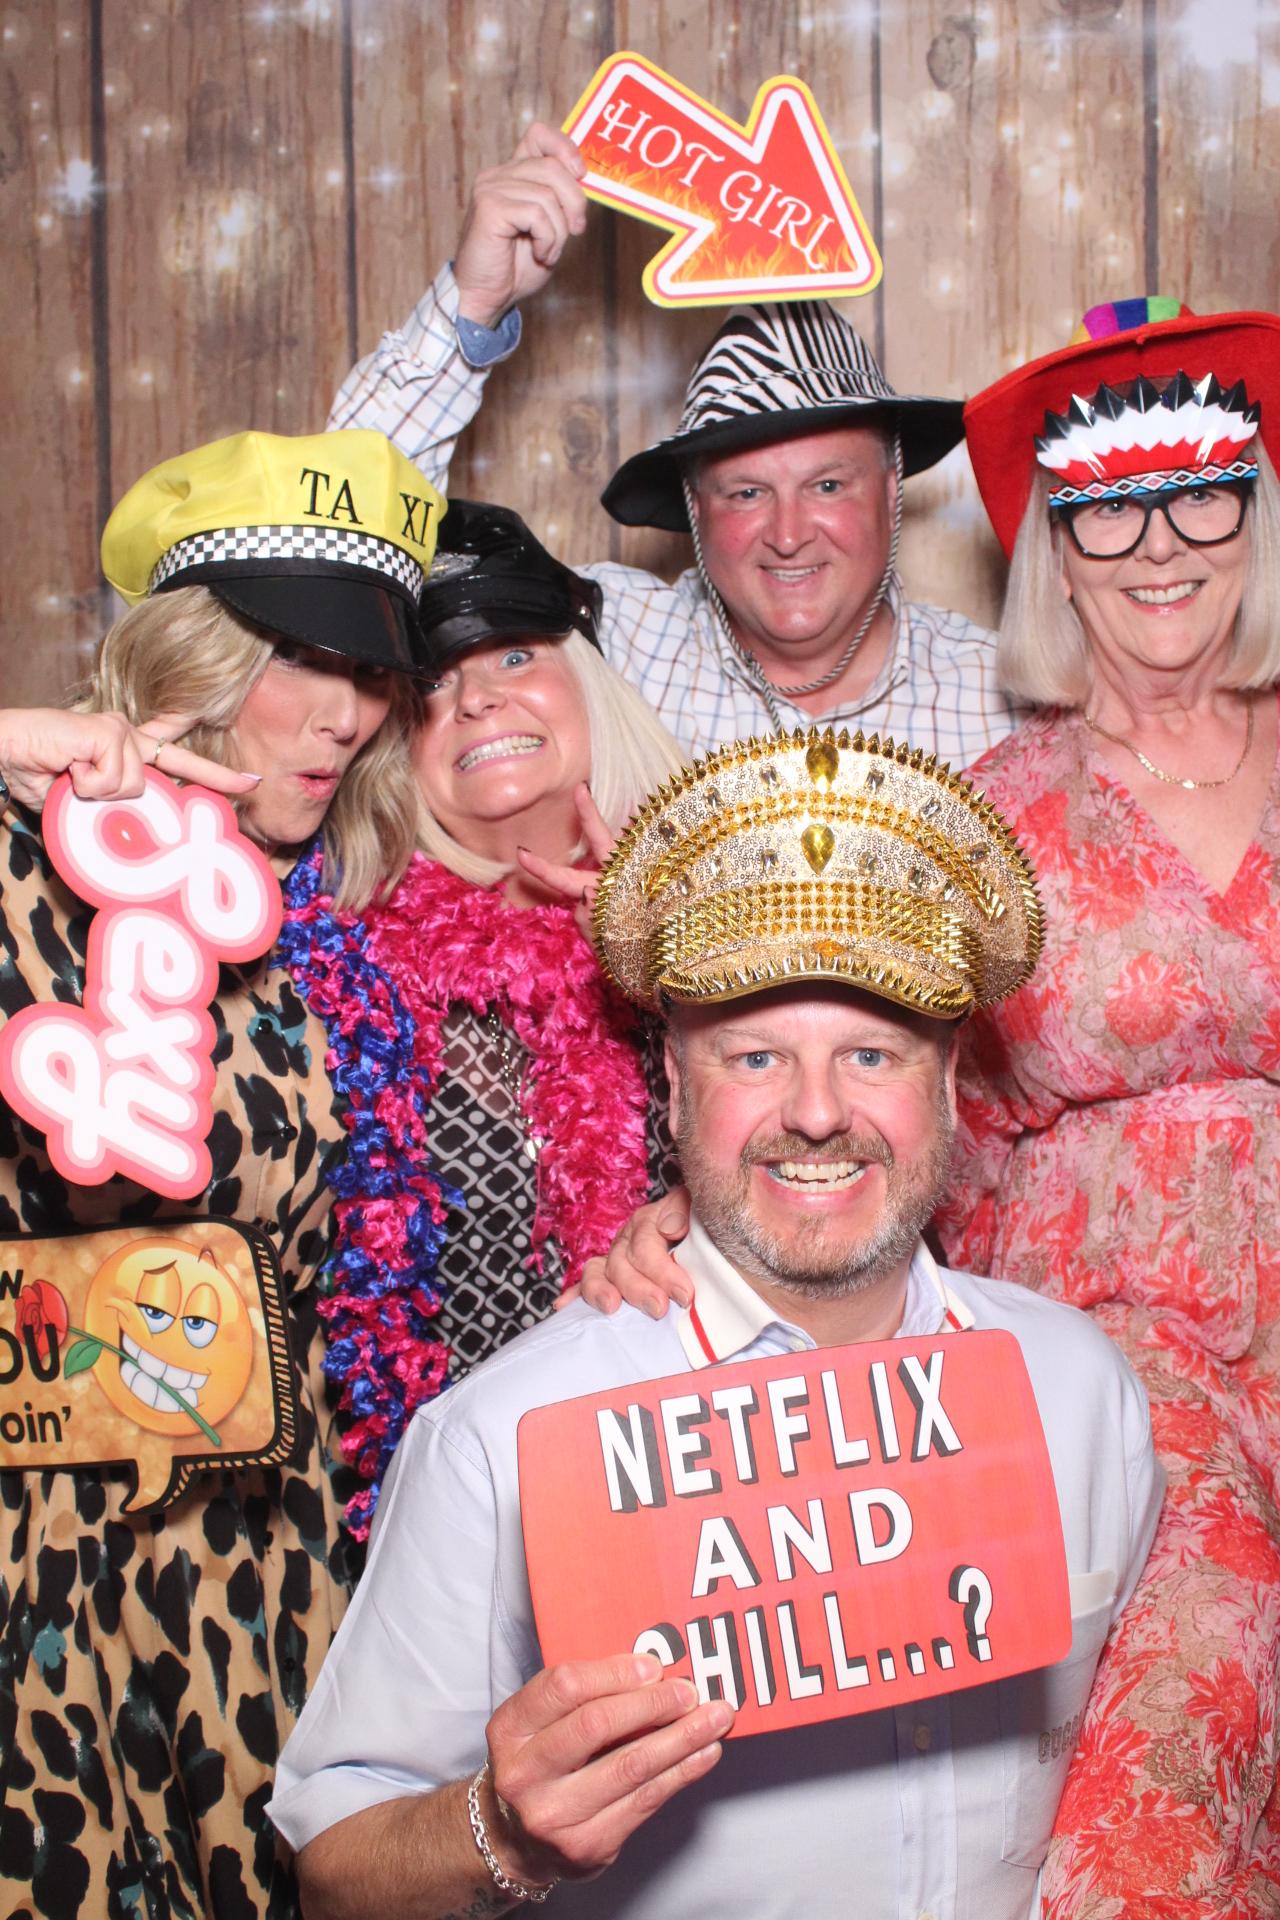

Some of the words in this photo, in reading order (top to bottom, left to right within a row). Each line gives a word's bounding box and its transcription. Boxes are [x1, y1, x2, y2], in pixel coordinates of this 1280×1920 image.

[597, 99, 725, 188] HOT
[719, 170, 835, 271] GIRL
[20, 775, 259, 1176] Sexy
[596, 1350, 963, 1513] NETFLIX
[691, 1487, 913, 1599] AND
